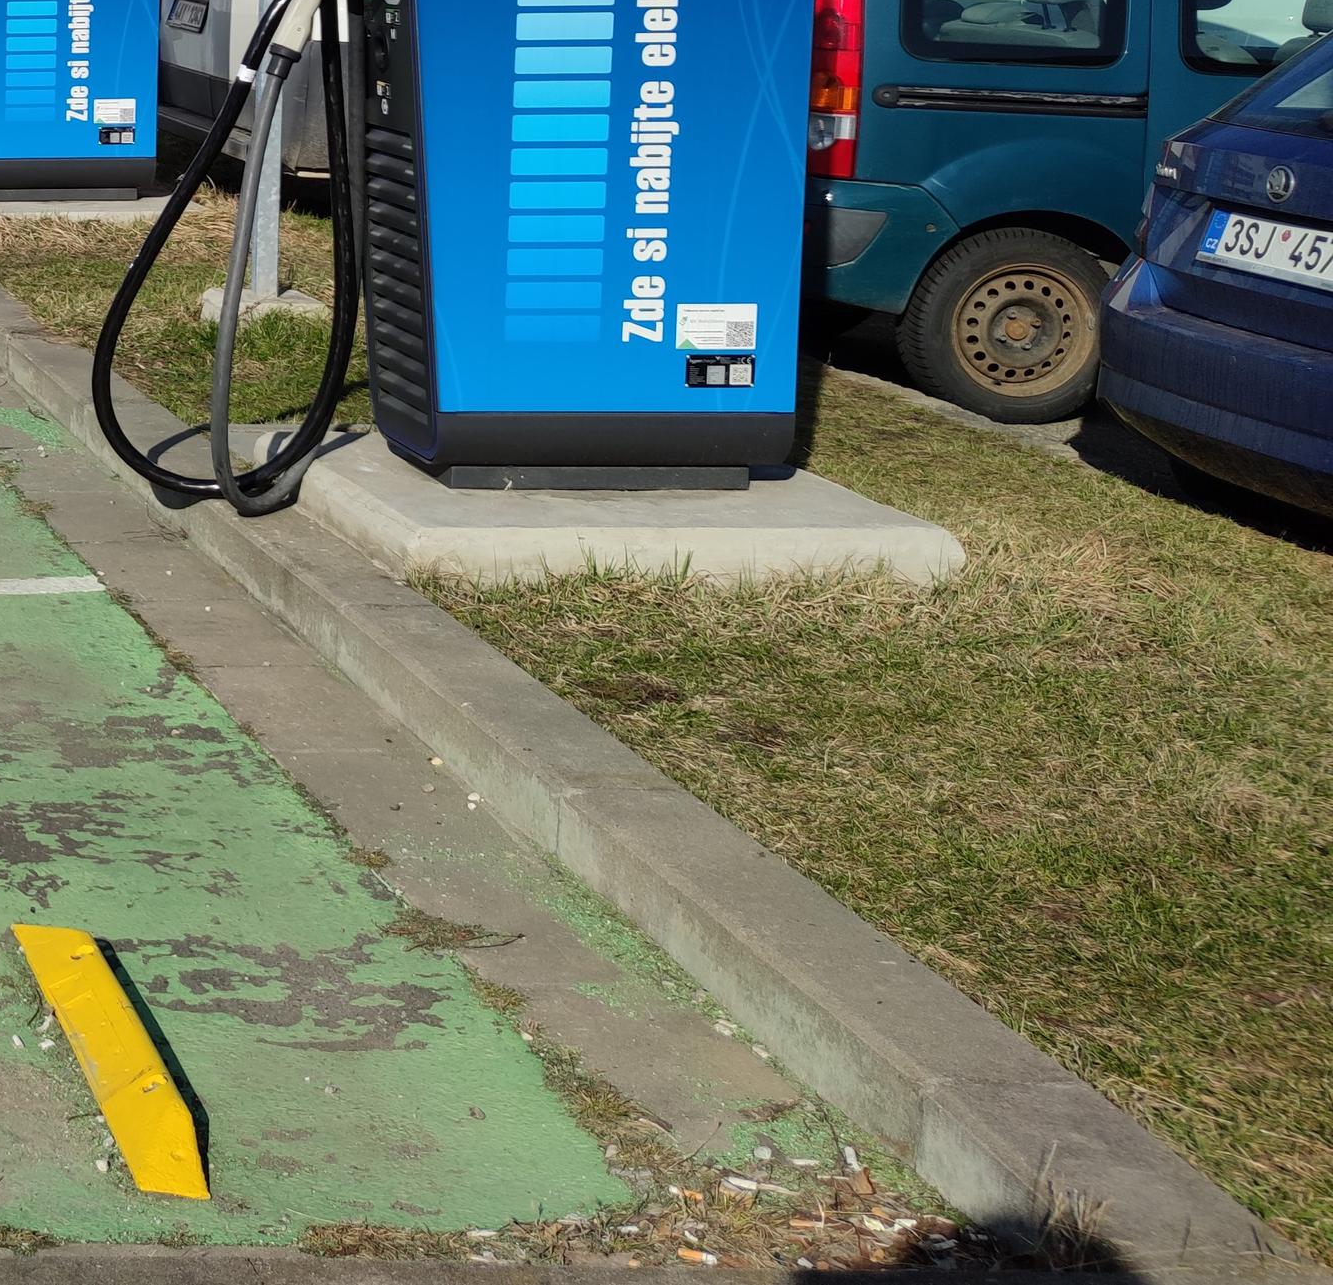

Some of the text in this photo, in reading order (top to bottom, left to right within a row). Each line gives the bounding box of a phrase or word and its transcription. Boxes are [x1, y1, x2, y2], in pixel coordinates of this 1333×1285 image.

[68, 60, 89, 79] si
[66, 85, 89, 121] Zde
[629, 79, 680, 214] nabijte
[626, 228, 668, 262] si
[1205, 237, 1218, 249] CZ
[1224, 219, 1277, 259] 3SJ
[622, 276, 666, 342] Zde
